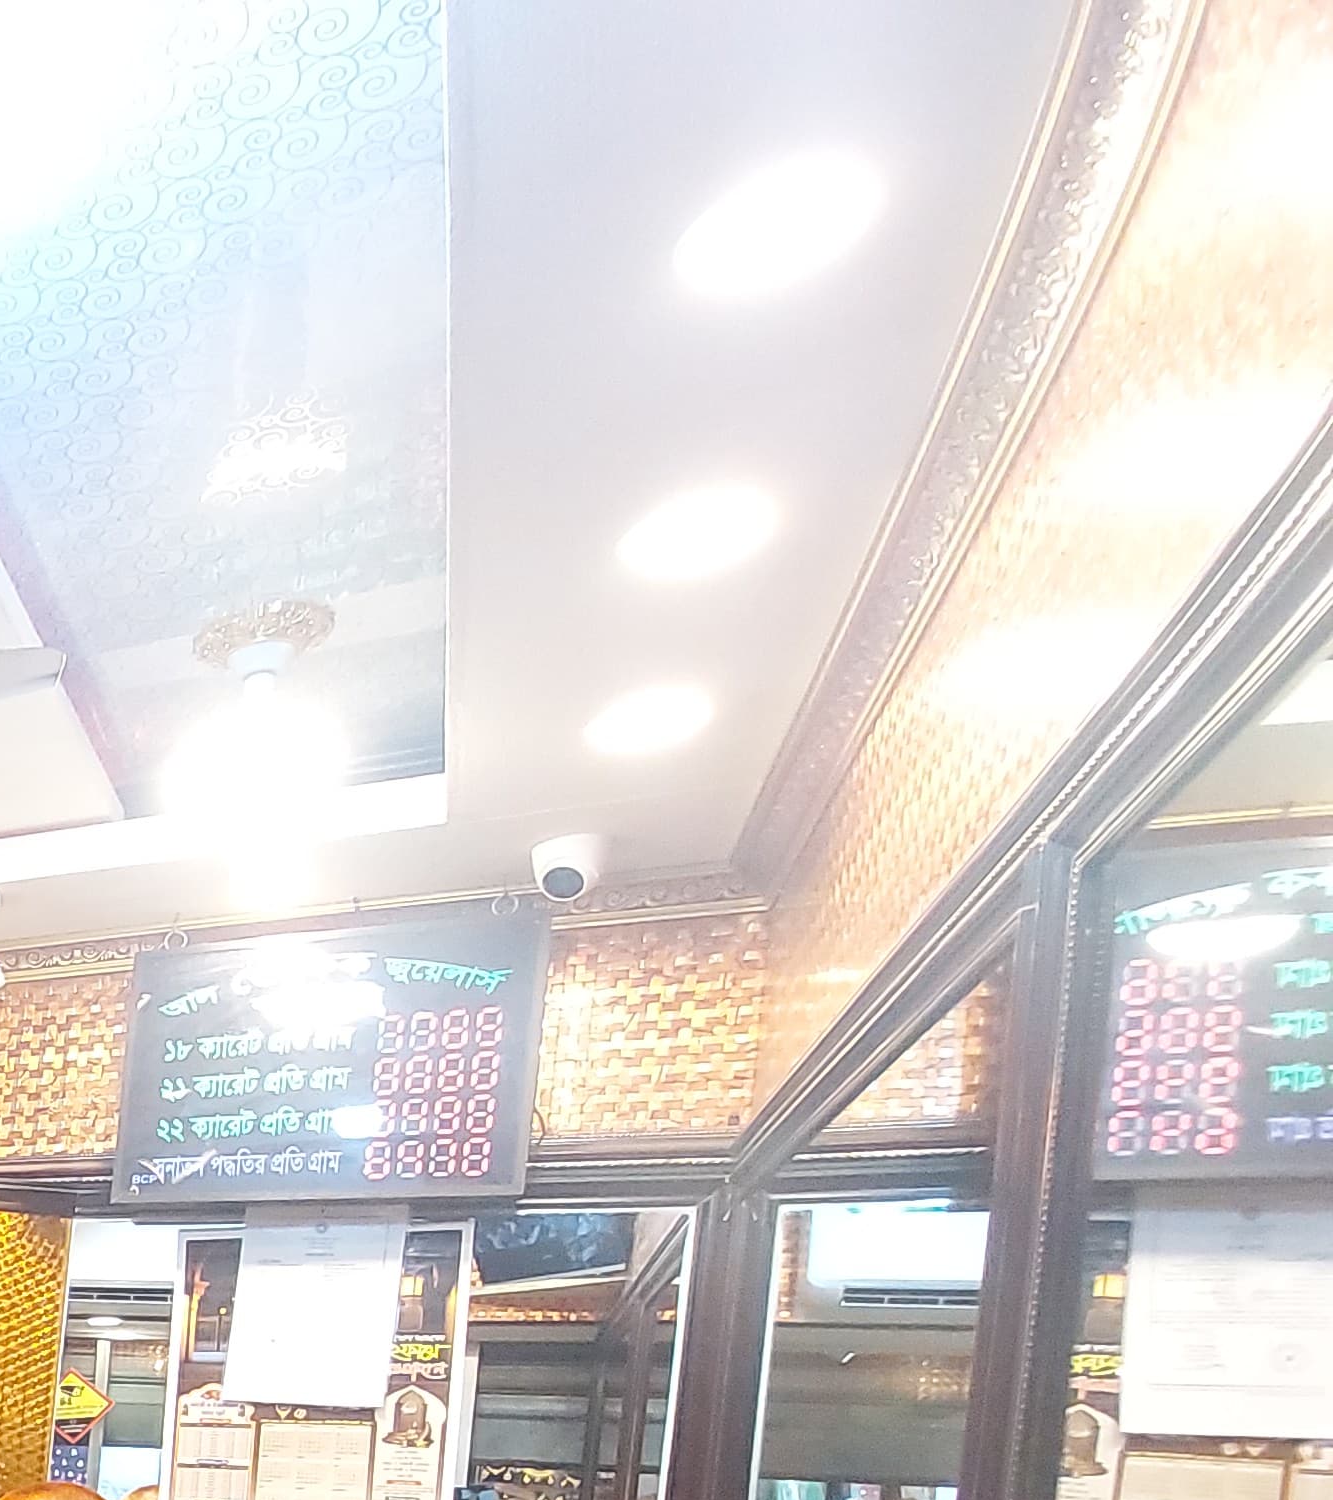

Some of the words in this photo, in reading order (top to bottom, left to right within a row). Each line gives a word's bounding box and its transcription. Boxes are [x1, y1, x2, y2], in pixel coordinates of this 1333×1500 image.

[164, 1039, 195, 1063] ১৮
[196, 1027, 264, 1060] ক্যারেট
[192, 1066, 260, 1098] ক্যারেট
[263, 1063, 309, 1094] প্রতি
[309, 1064, 352, 1092] গ্রাম
[156, 1118, 185, 1143] ২২
[189, 1108, 257, 1140] ক্যারেট
[259, 1104, 304, 1134] প্রতি
[210, 1148, 268, 1177] পদ্ধতির
[270, 1145, 307, 1176] প্রতি
[308, 1148, 343, 1175] গ্রাম
